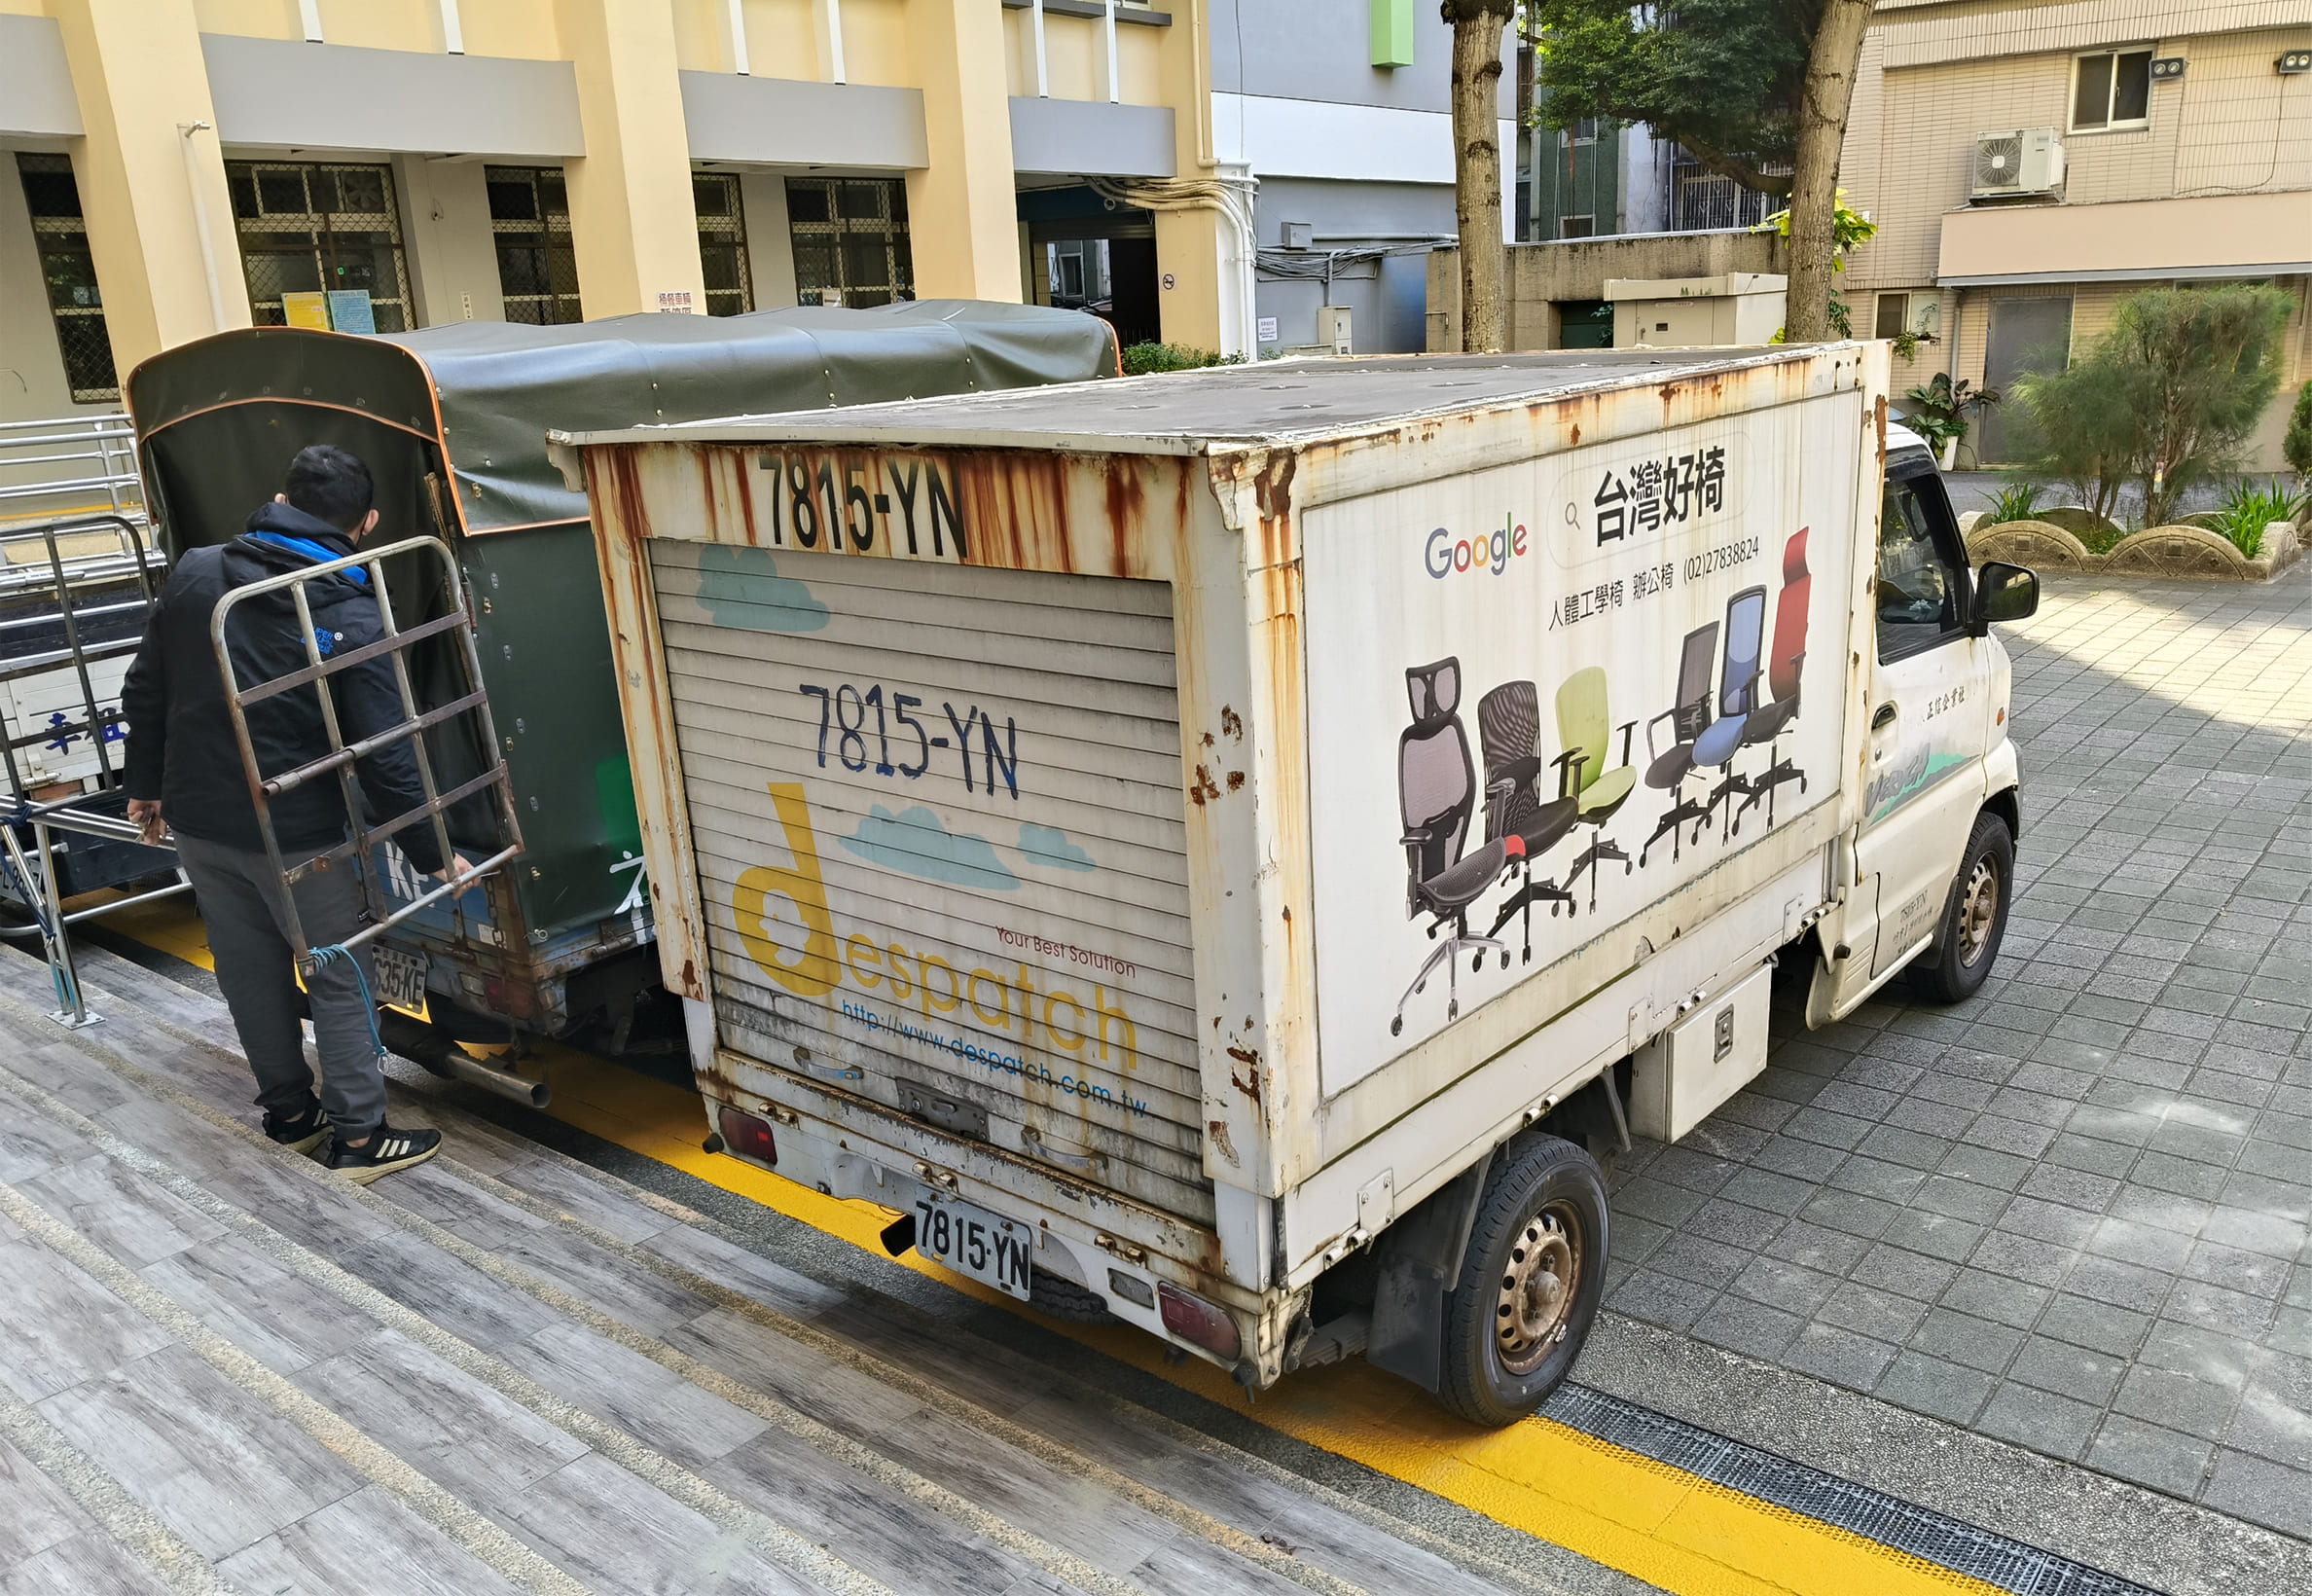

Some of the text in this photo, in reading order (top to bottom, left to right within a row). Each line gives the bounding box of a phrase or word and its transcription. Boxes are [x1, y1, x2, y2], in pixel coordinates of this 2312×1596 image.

[758, 452, 968, 558] 7815-YN
[1425, 511, 1528, 579] Google
[1594, 446, 1725, 547] 台灣好椅
[1548, 536, 1759, 631] 人體工學椅 辦公椅 (02)27838824
[800, 684, 1018, 800] 7815-YN
[733, 781, 1138, 1070] despatch
[996, 925, 1136, 979] Your Best Solution
[374, 957, 424, 1006] 635-KE
[843, 999, 1147, 1118] http://www.despatch.com.tw
[916, 1200, 1029, 1290] 7815-YN
